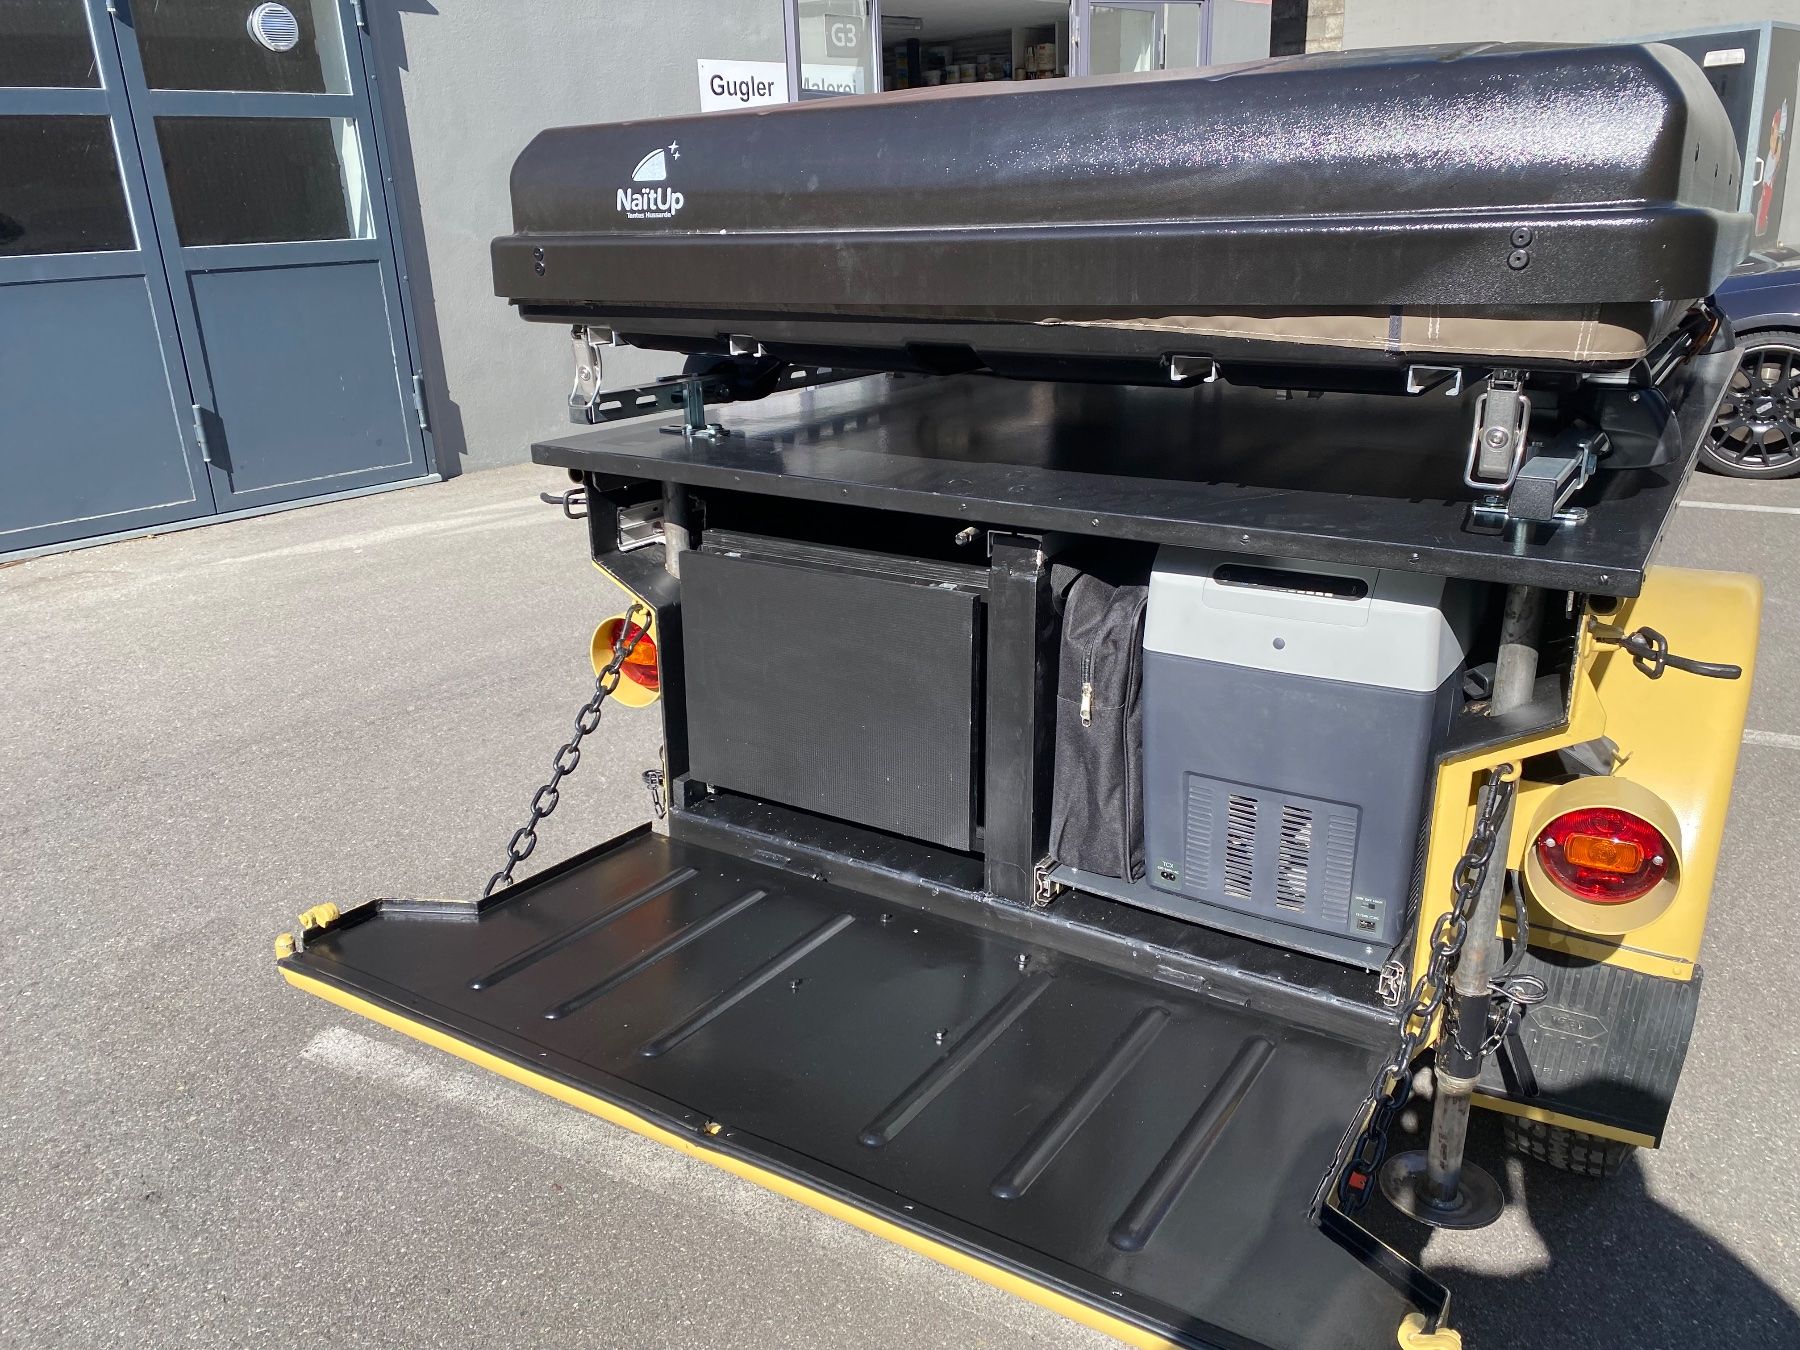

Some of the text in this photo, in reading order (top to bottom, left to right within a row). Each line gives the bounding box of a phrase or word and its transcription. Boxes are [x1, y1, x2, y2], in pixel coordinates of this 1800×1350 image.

[831, 23, 857, 48] G3
[710, 74, 775, 103] Gugler
[616, 187, 685, 216] NaïtUp
